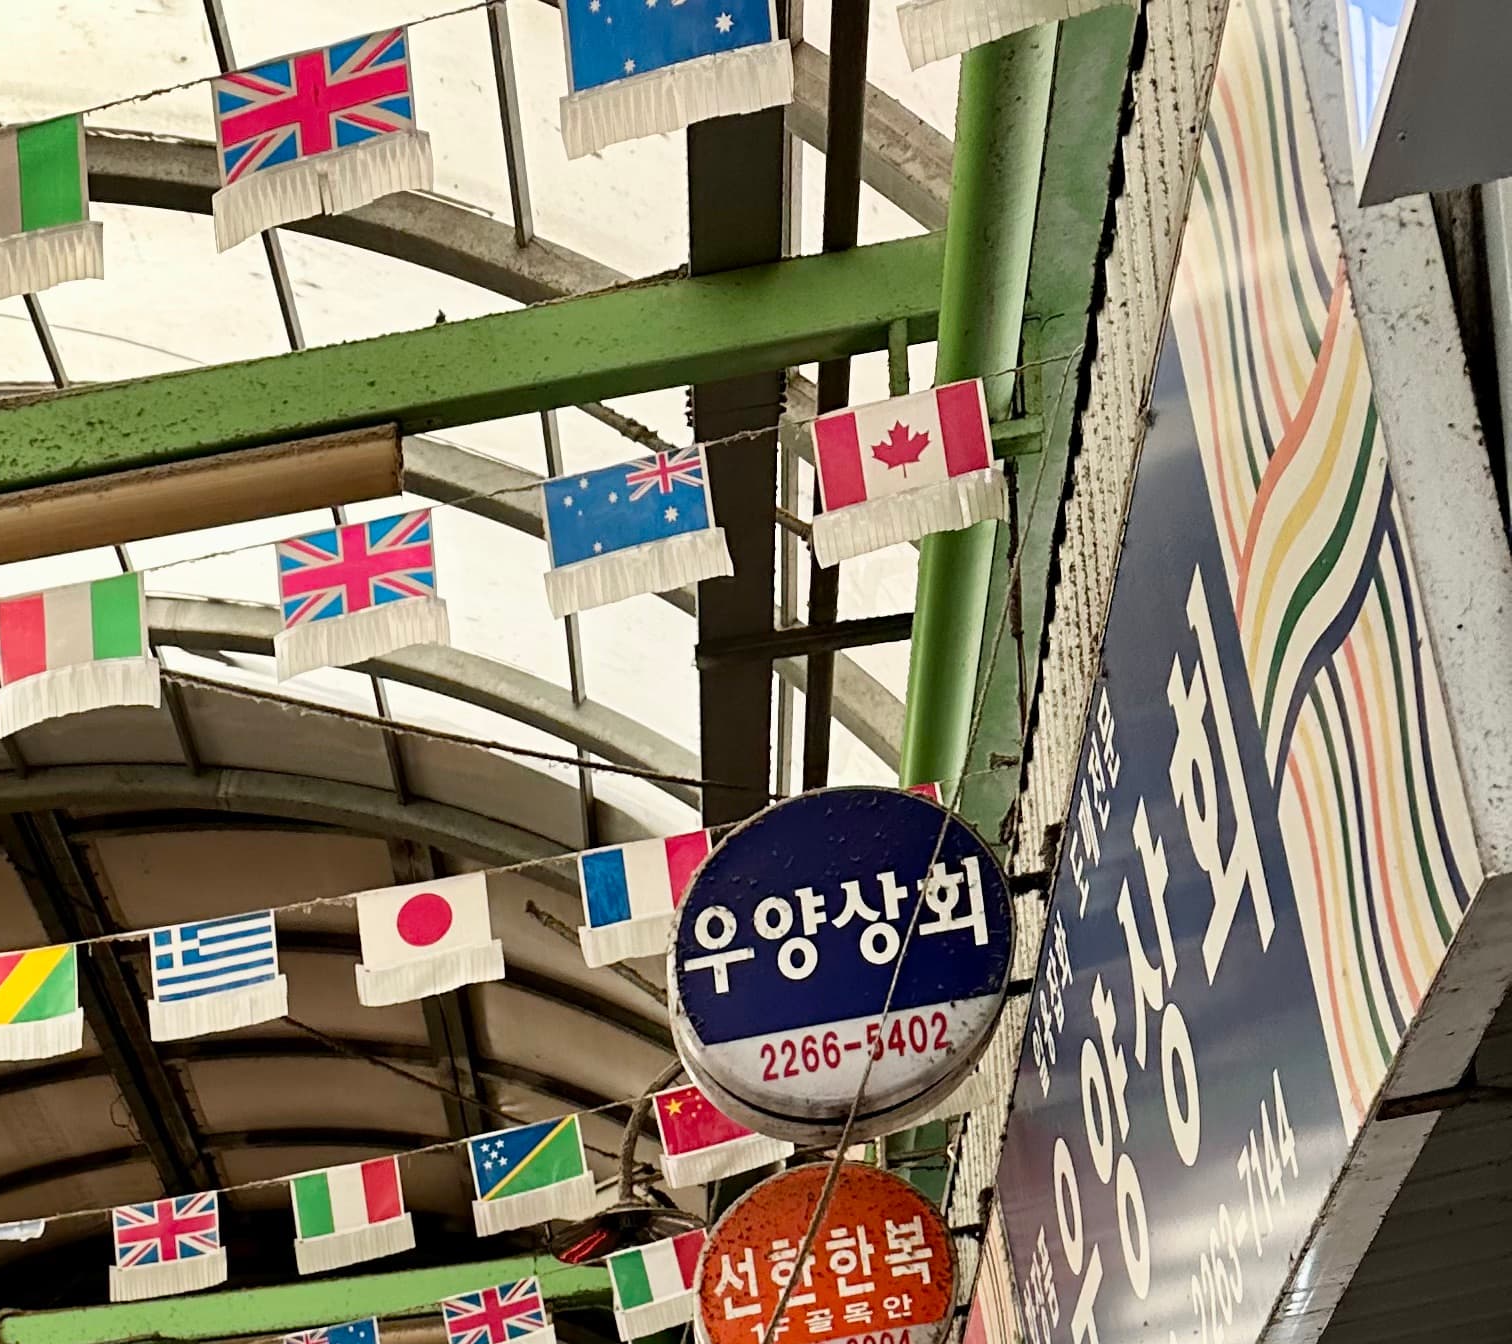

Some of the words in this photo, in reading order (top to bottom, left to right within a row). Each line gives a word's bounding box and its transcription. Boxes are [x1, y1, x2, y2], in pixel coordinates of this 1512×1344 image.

[684, 855, 989, 994] 우양상회
[1032, 909, 1073, 1098] 일용잡화
[1070, 687, 1120, 919] 도매전문
[760, 1012, 950, 1082] 2266-5402
[713, 1215, 934, 1321] 선한한복
